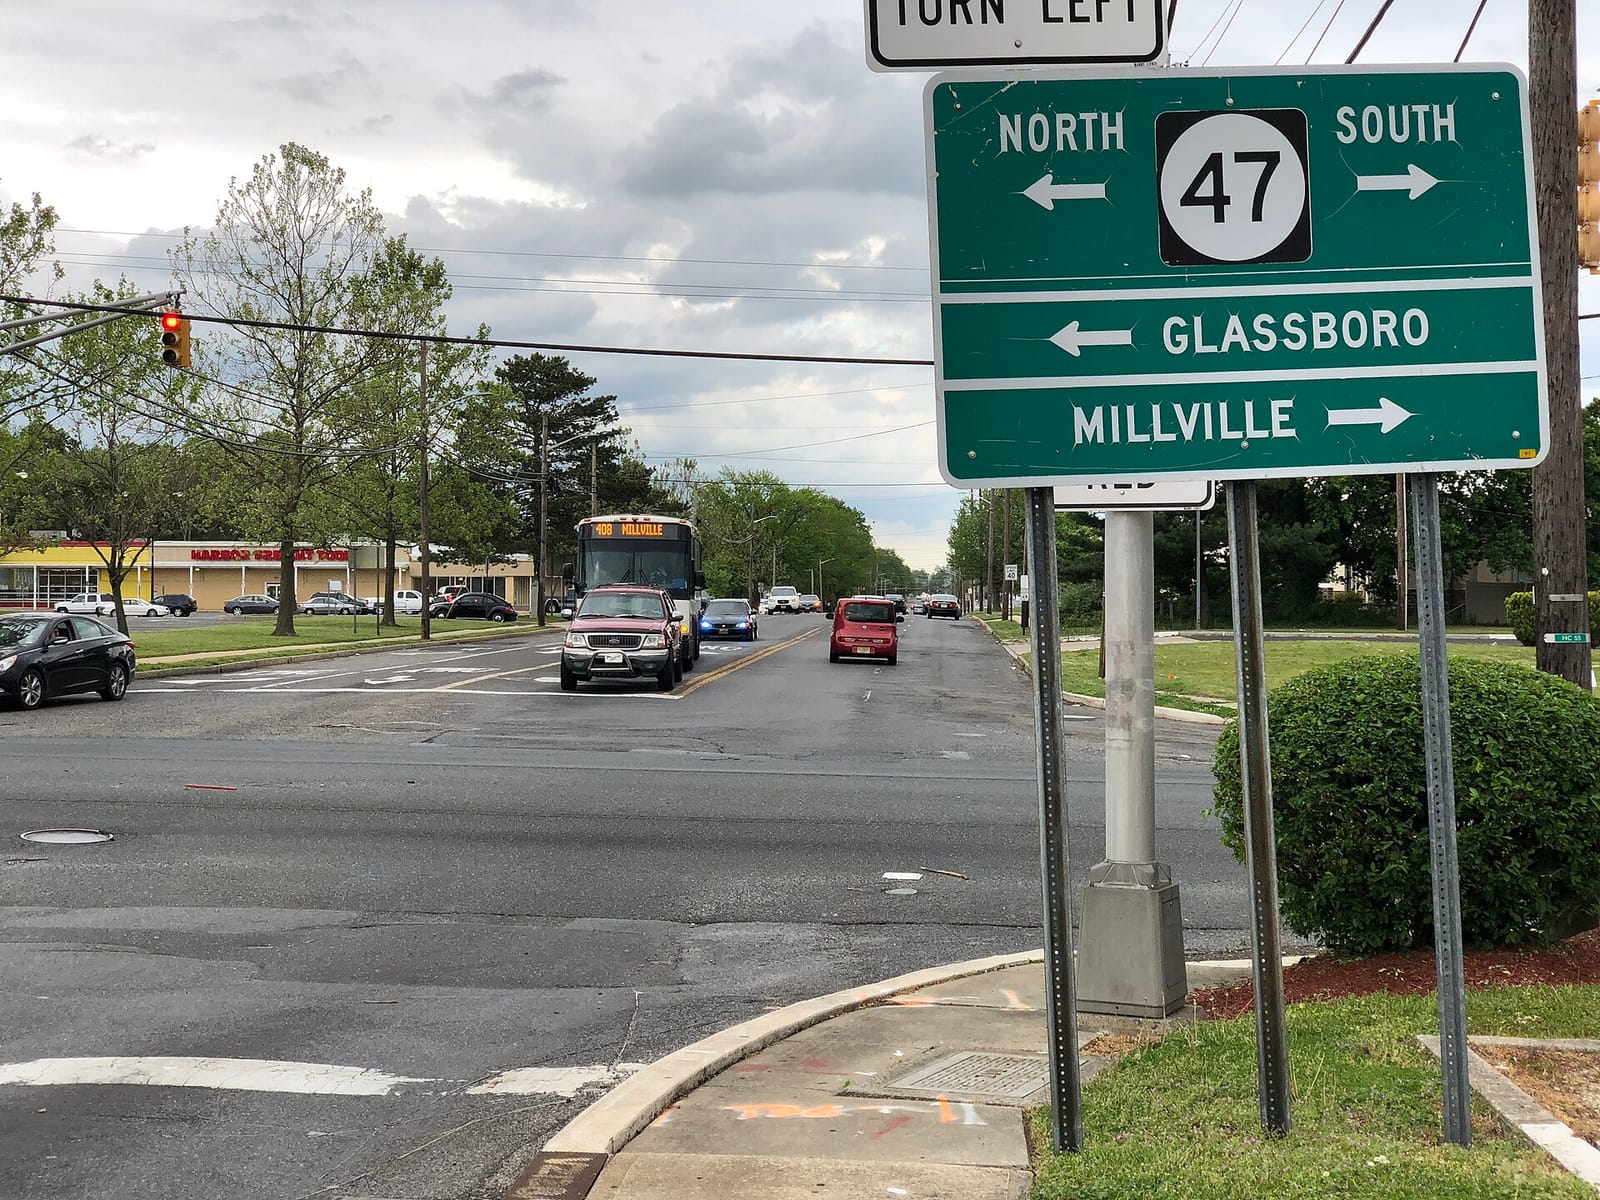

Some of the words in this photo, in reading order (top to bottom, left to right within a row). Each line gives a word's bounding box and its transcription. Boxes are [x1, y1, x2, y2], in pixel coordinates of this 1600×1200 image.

[1000, 112, 1125, 152] NORTH
[1336, 104, 1457, 144] SOUTH
[1180, 150, 1282, 224] 47
[1163, 308, 1430, 355] GLASSBORO
[1074, 400, 1297, 444] MILLVILLE
[595, 523, 613, 536] 408
[622, 523, 664, 536] MILLVILLE
